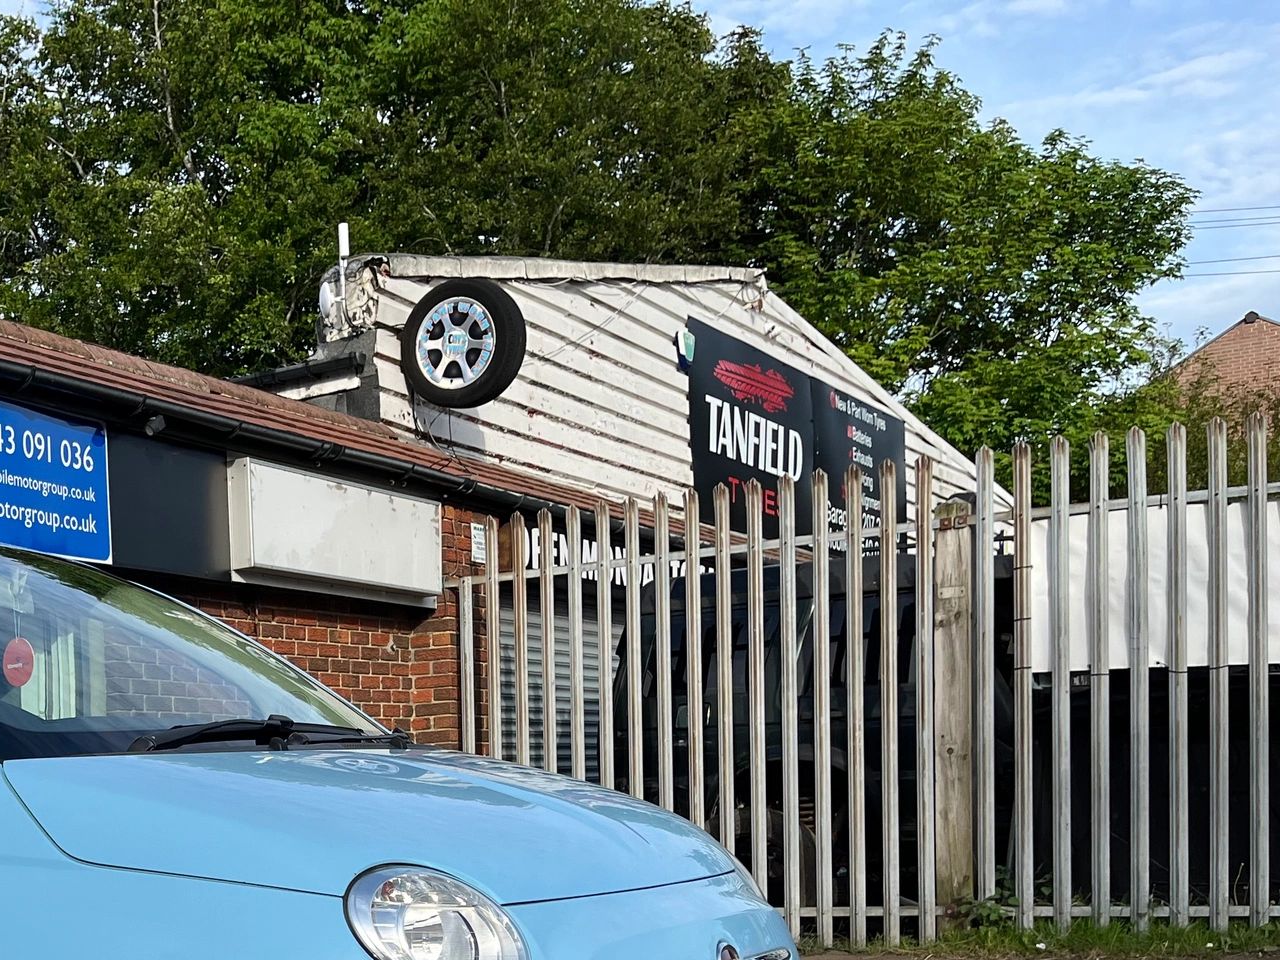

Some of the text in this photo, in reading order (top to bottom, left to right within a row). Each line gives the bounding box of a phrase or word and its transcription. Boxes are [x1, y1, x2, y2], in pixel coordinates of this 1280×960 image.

[22, 430, 52, 463] 091
[60, 440, 94, 472] 036
[705, 394, 803, 482] TANFIELD
